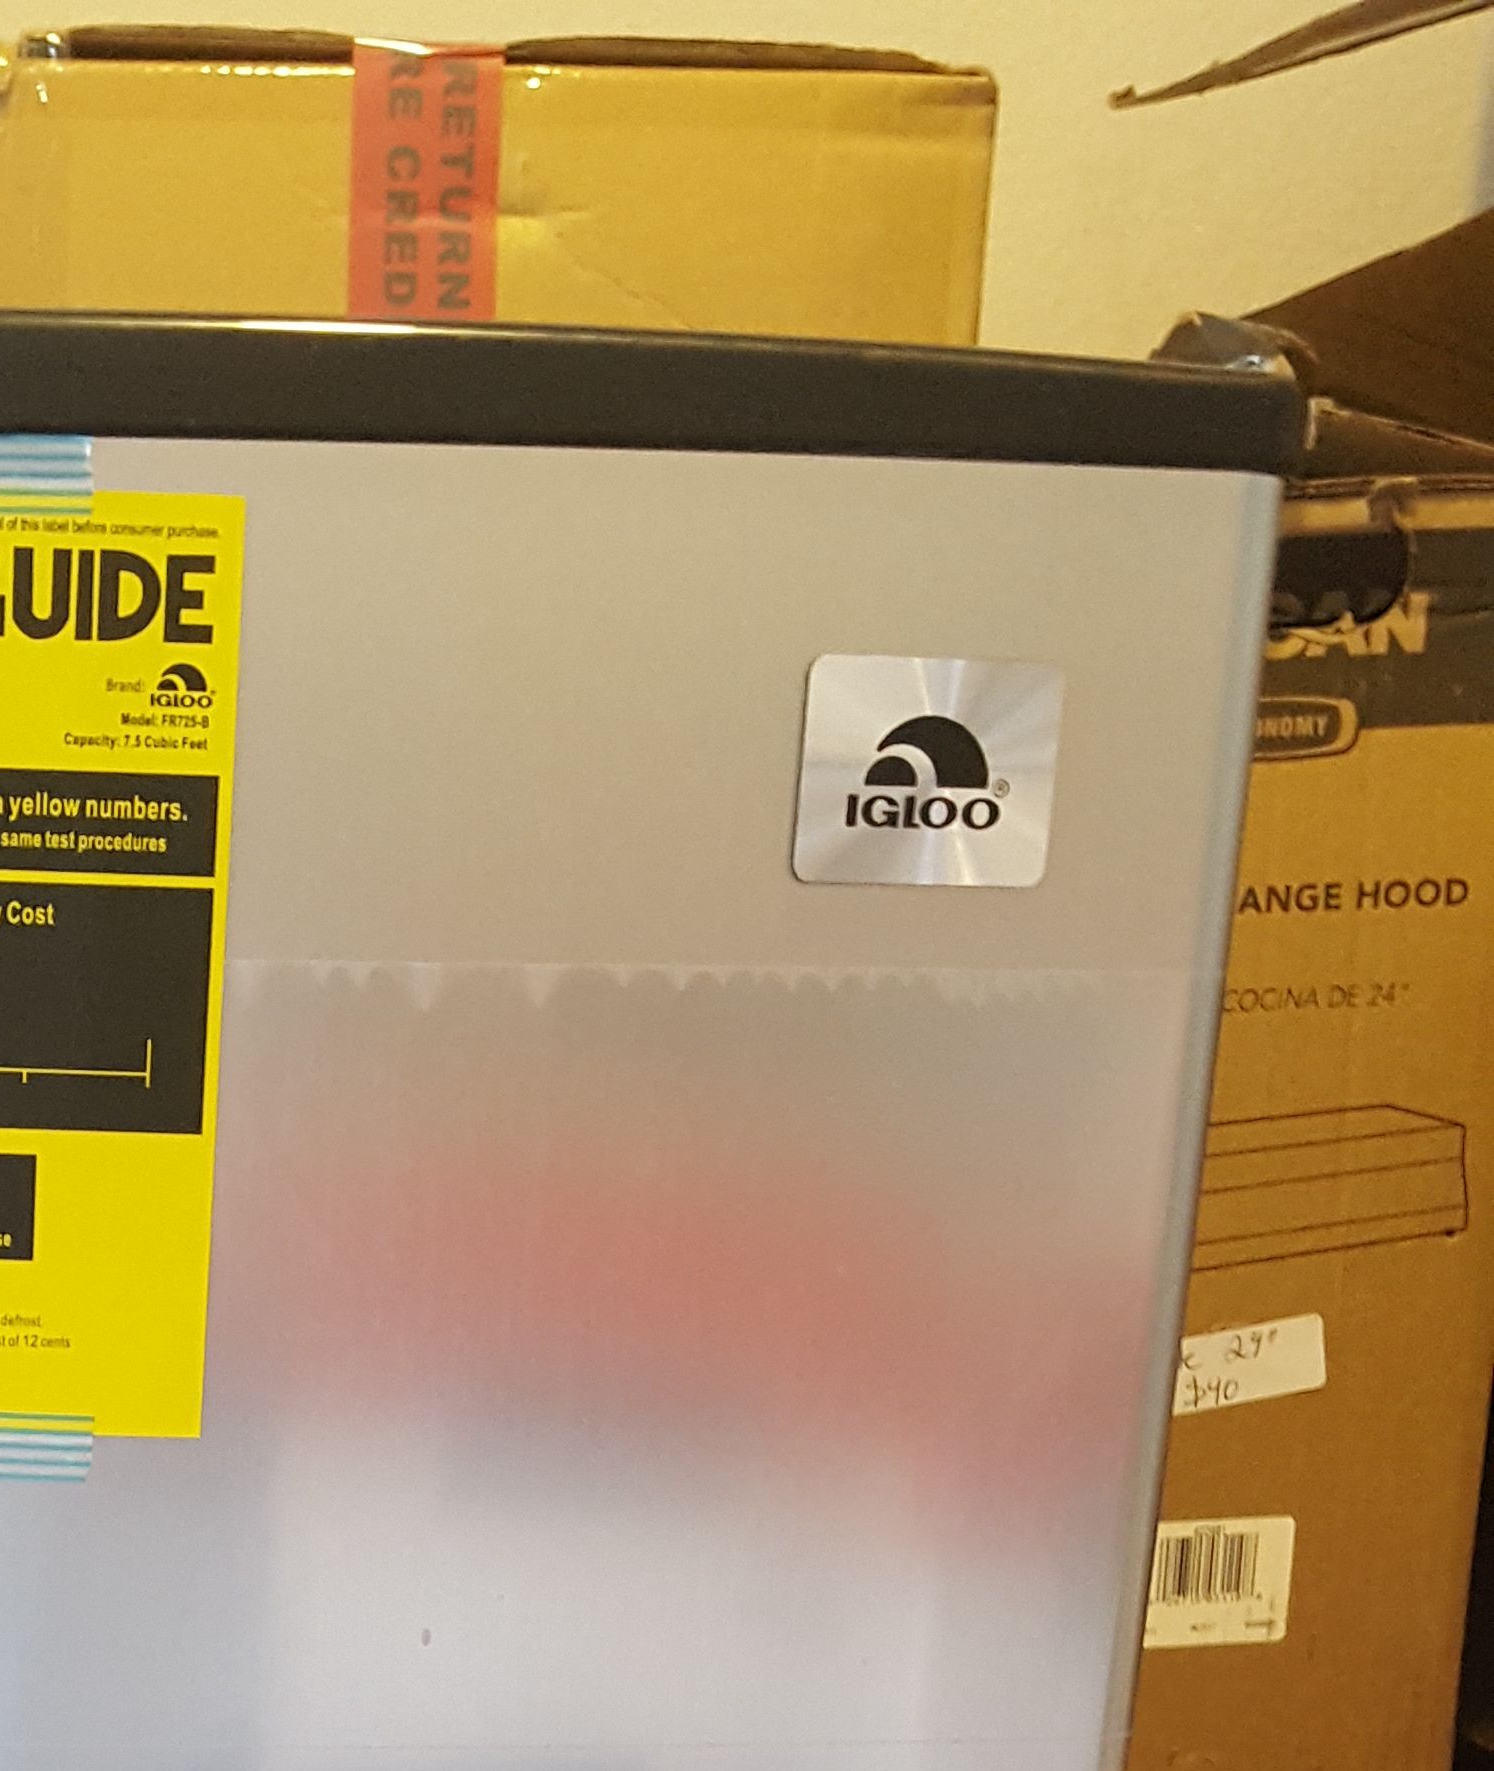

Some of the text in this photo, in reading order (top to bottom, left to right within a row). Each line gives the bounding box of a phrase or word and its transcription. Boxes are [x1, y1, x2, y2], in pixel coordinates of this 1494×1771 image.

[437, 60, 478, 310] RETURN
[383, 146, 422, 306] CRED
[7, 516, 18, 530] of
[106, 679, 213, 708] Brand: IGLOO
[121, 713, 155, 726] Model:
[64, 732, 208, 750] Capacity: 7.5 Cubic Feet
[8, 792, 81, 822] yellow
[85, 795, 188, 822] numbers.
[845, 794, 1000, 830] IGLOO
[0, 832, 43, 849] same
[45, 831, 76, 850] test
[78, 832, 168, 853] procedures
[1238, 878, 1469, 915] ANGE HOOD
[6, 900, 55, 926] Cost
[1328, 984, 1358, 1008] DE
[8, 1334, 20, 1347] of
[23, 1334, 38, 1348] 12
[40, 1335, 71, 1348] cents
